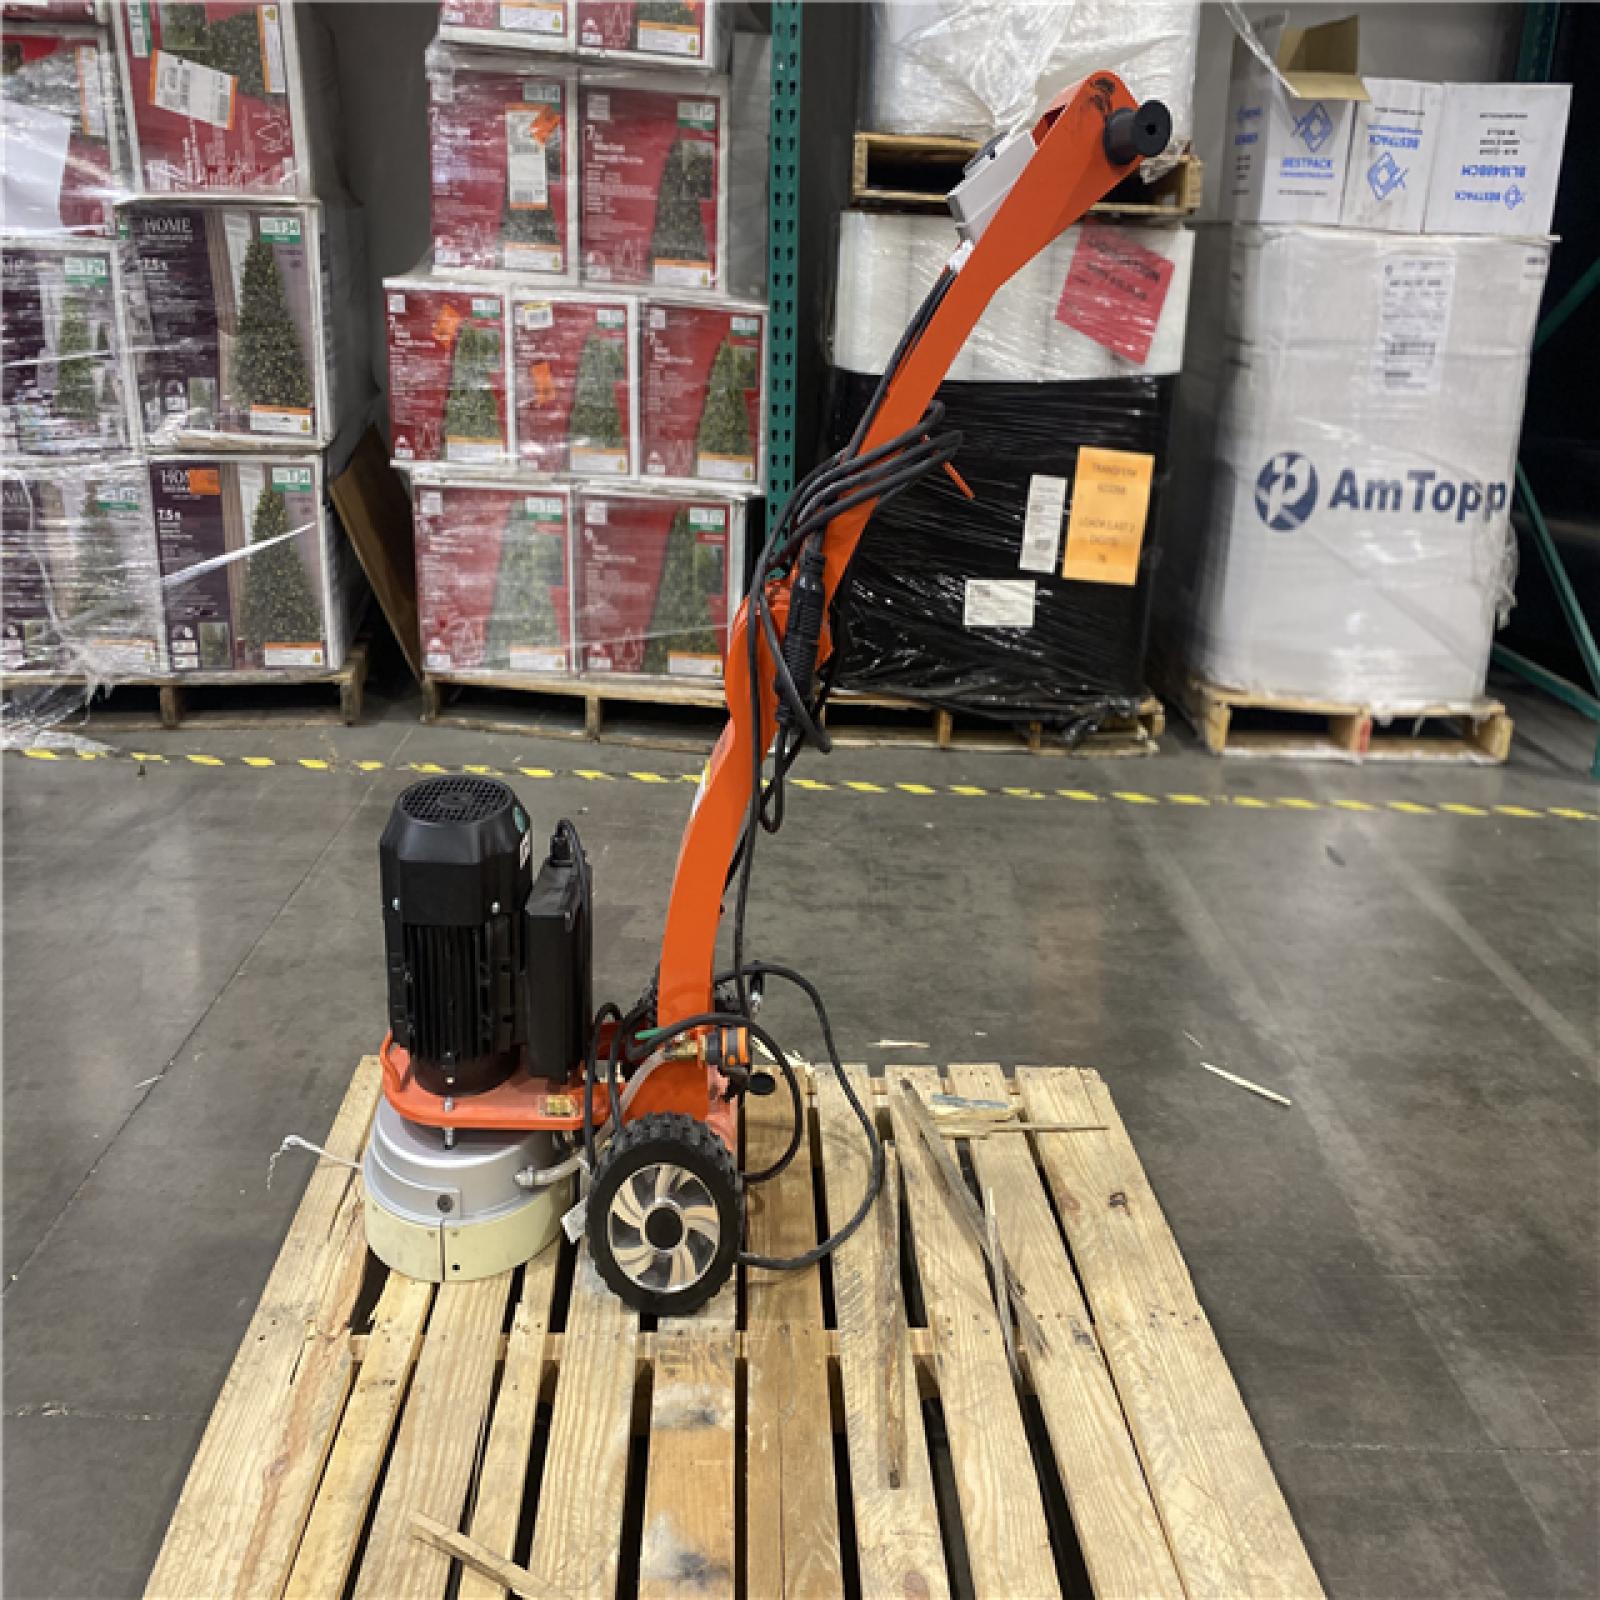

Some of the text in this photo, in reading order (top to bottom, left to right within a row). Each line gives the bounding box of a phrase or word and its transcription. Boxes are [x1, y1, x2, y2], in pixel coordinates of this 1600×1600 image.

[1282, 157, 1334, 170] BESTPACK
[1454, 190, 1501, 202] BESTPACK
[144, 216, 193, 233] HOME
[1328, 468, 1507, 523] AmTopp
